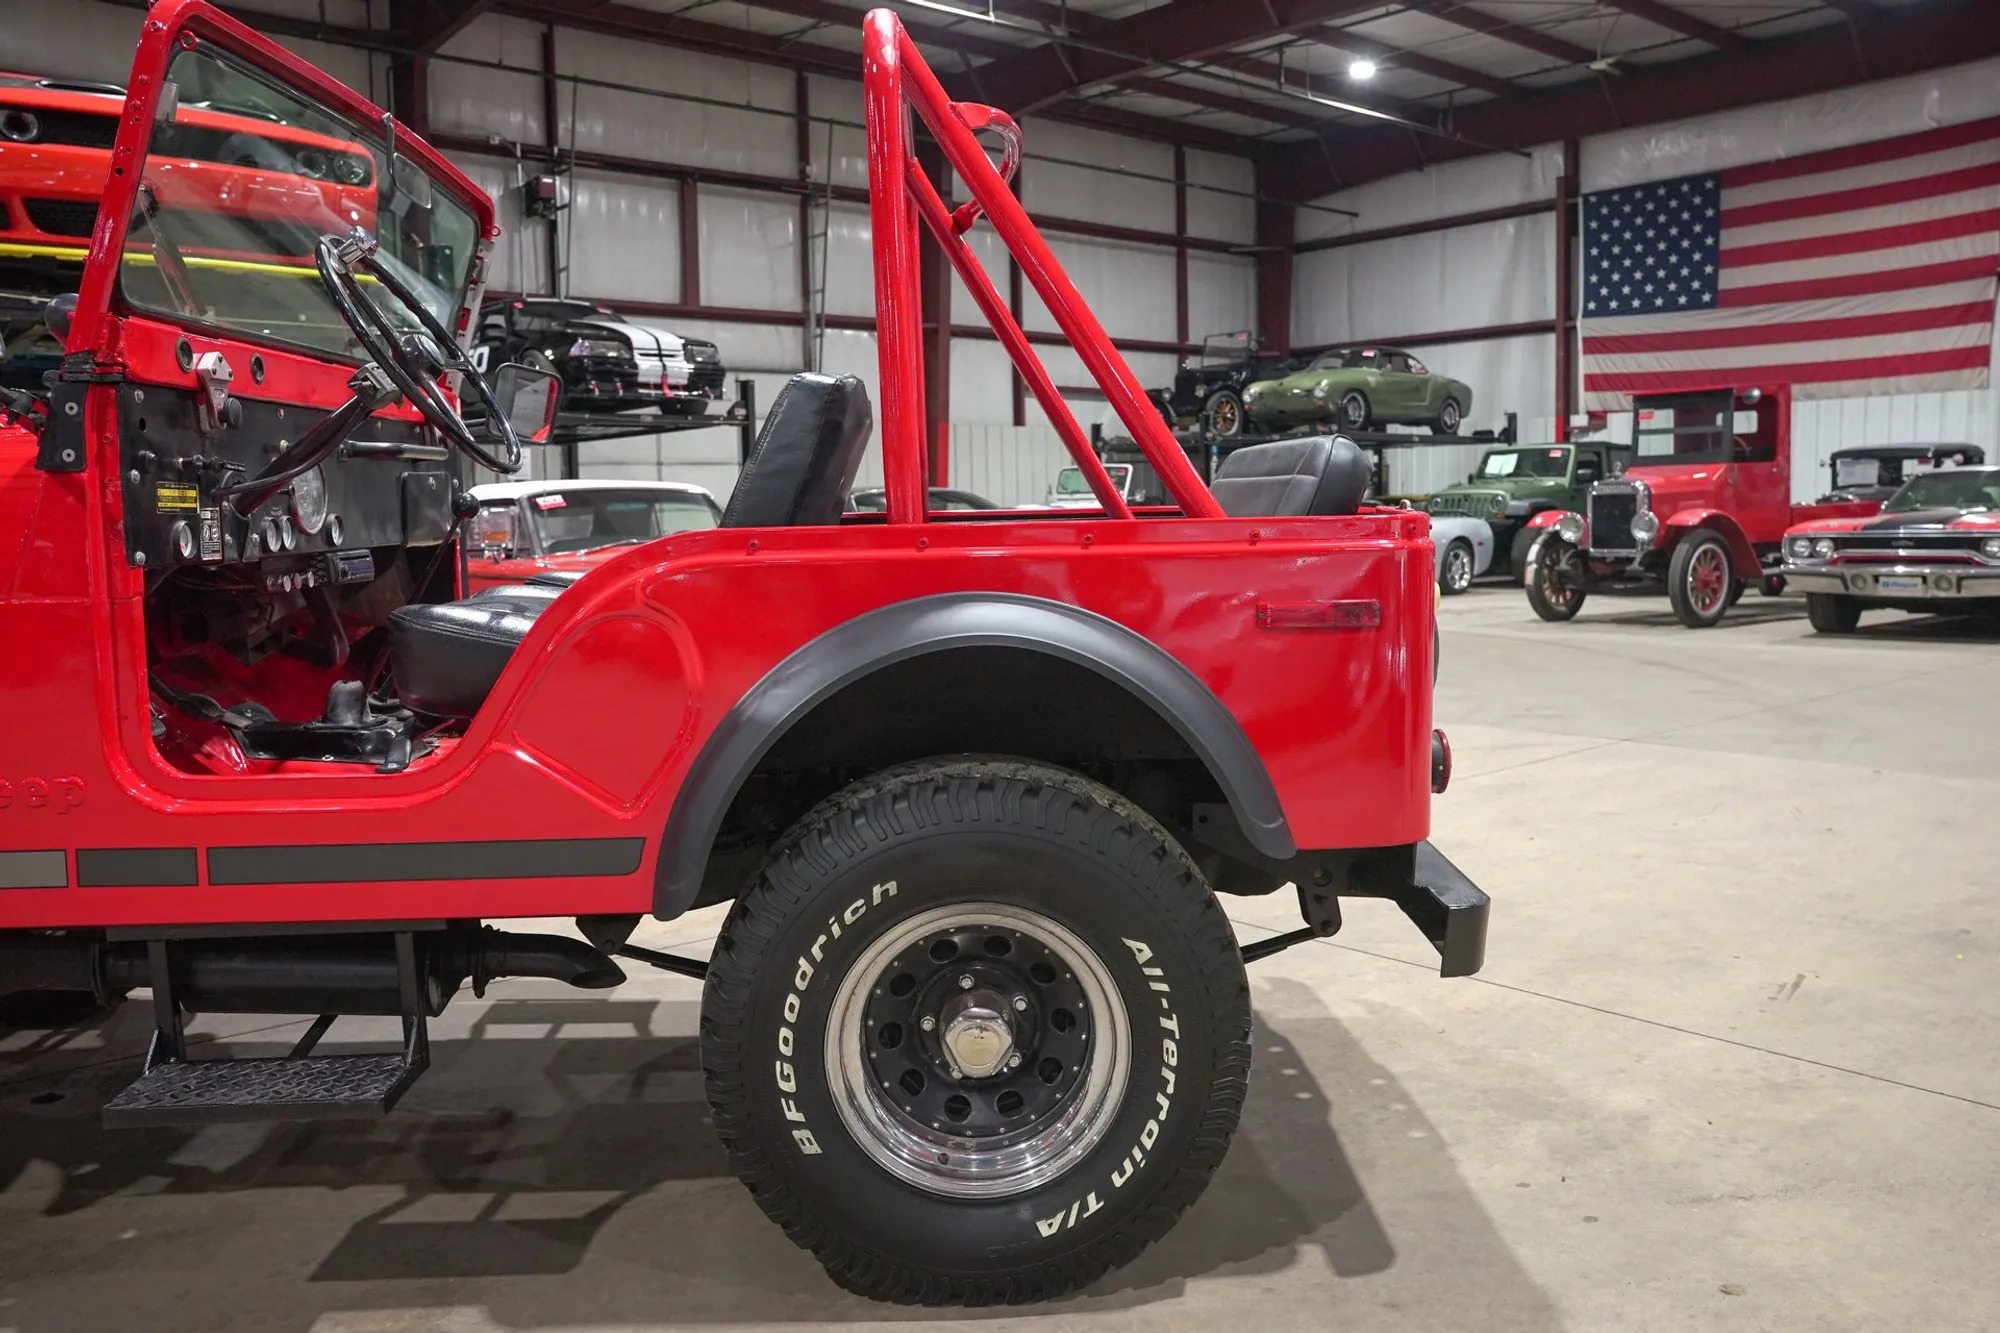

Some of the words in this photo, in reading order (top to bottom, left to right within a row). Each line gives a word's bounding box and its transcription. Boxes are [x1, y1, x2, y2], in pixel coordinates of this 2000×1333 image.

[775, 879, 898, 1155] BFGoodrich
[1110, 936, 1181, 1189] All-Terrain
[1035, 1191, 1105, 1238] T/A
